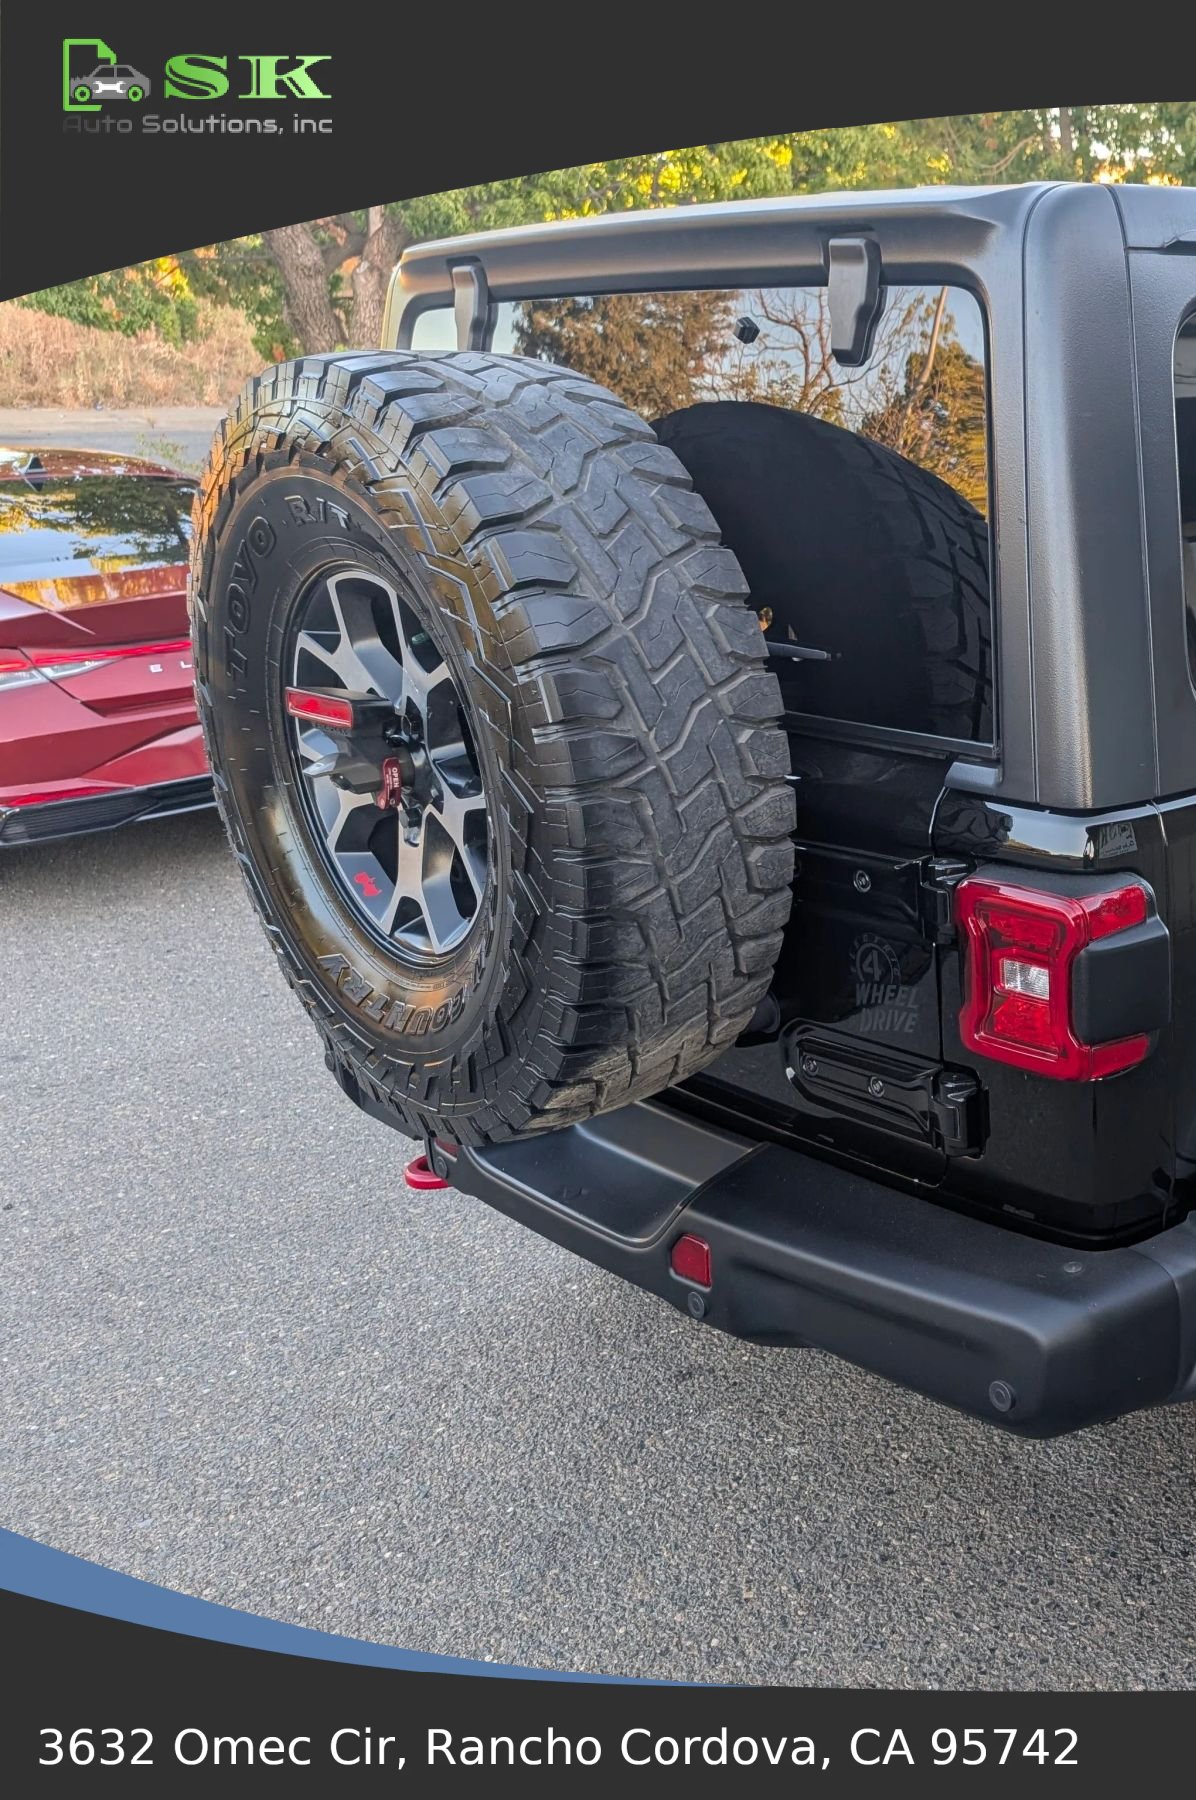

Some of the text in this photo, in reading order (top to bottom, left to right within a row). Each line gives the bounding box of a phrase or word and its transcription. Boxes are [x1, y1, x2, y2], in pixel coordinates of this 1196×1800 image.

[223, 516, 277, 682] TOYO
[862, 949, 881, 982] 4
[317, 953, 466, 1035] COUNTRY
[856, 983, 919, 1009] WHEEL
[860, 1007, 918, 1033] DRIVE
